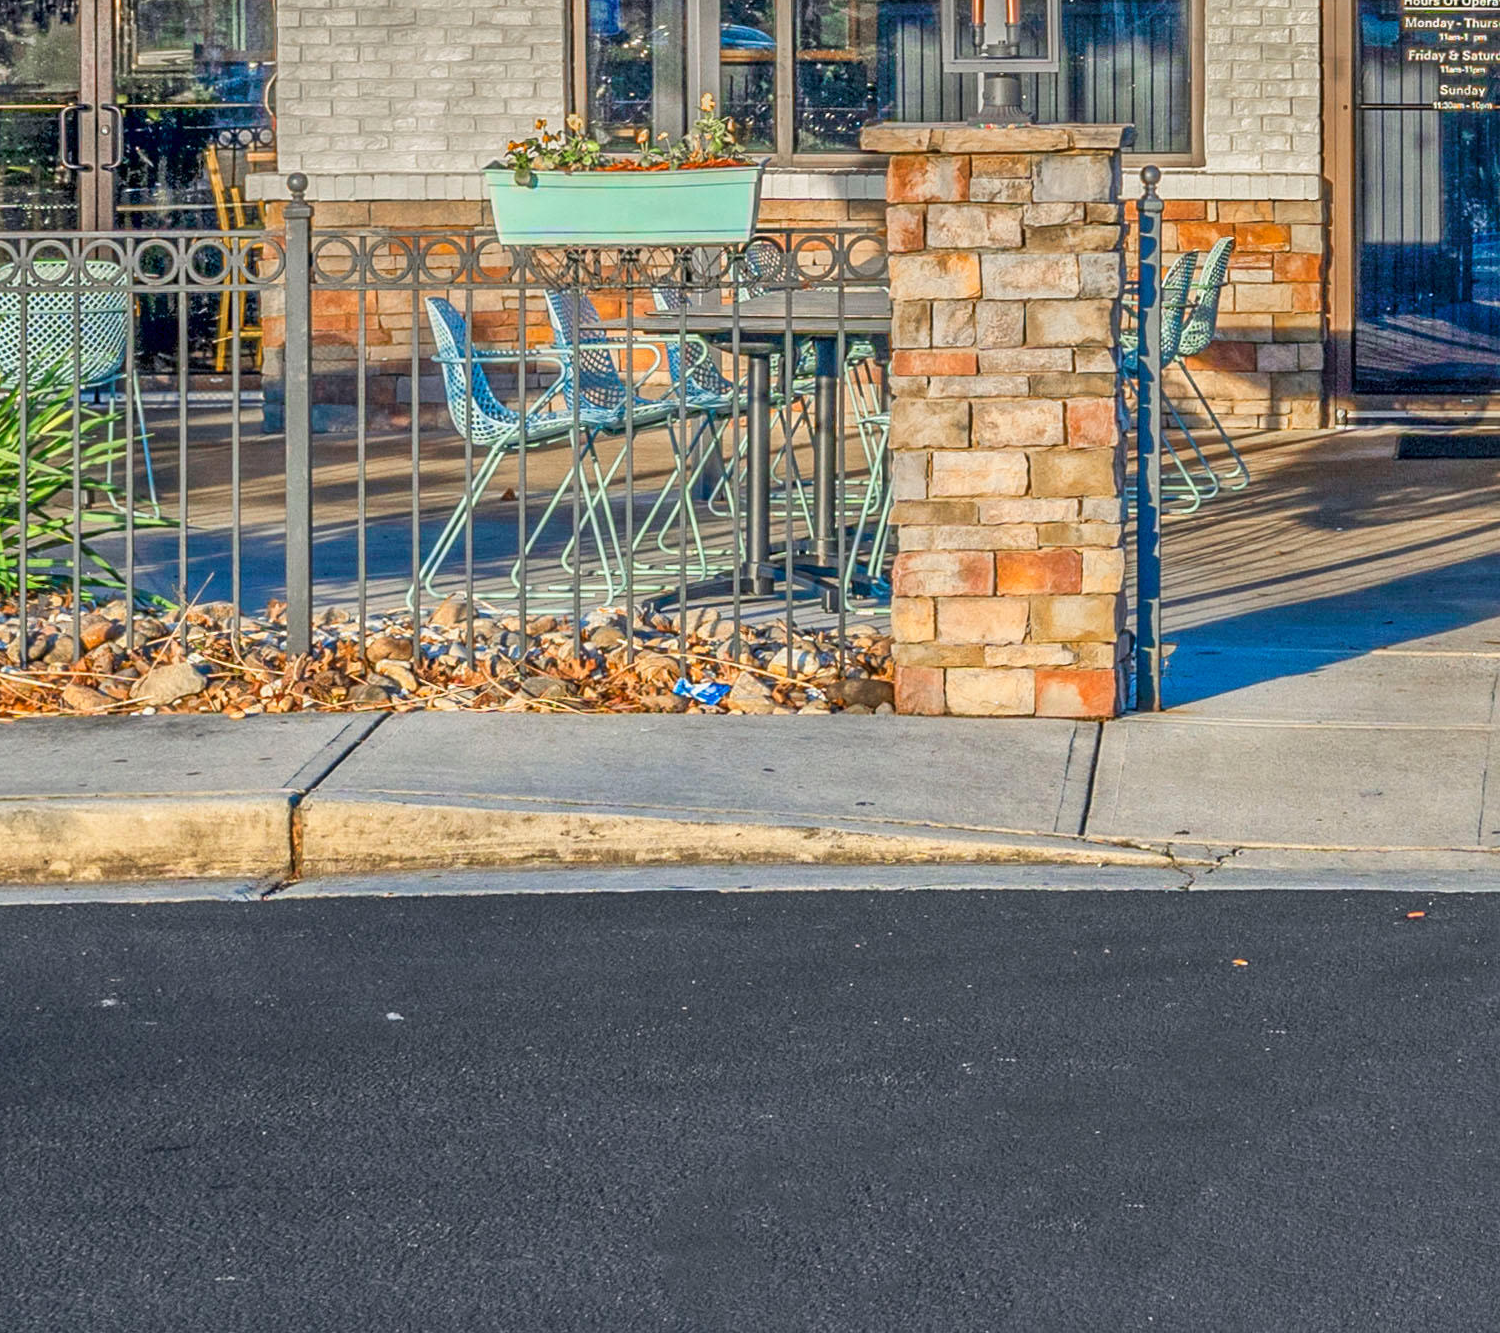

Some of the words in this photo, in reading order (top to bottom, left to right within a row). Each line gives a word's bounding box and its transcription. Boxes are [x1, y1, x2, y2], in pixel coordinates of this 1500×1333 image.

[1404, 17, 1455, 30] Monday
[1408, 50, 1446, 63] Friday
[1449, 50, 1459, 61] &
[1440, 85, 1486, 97] Sunday
